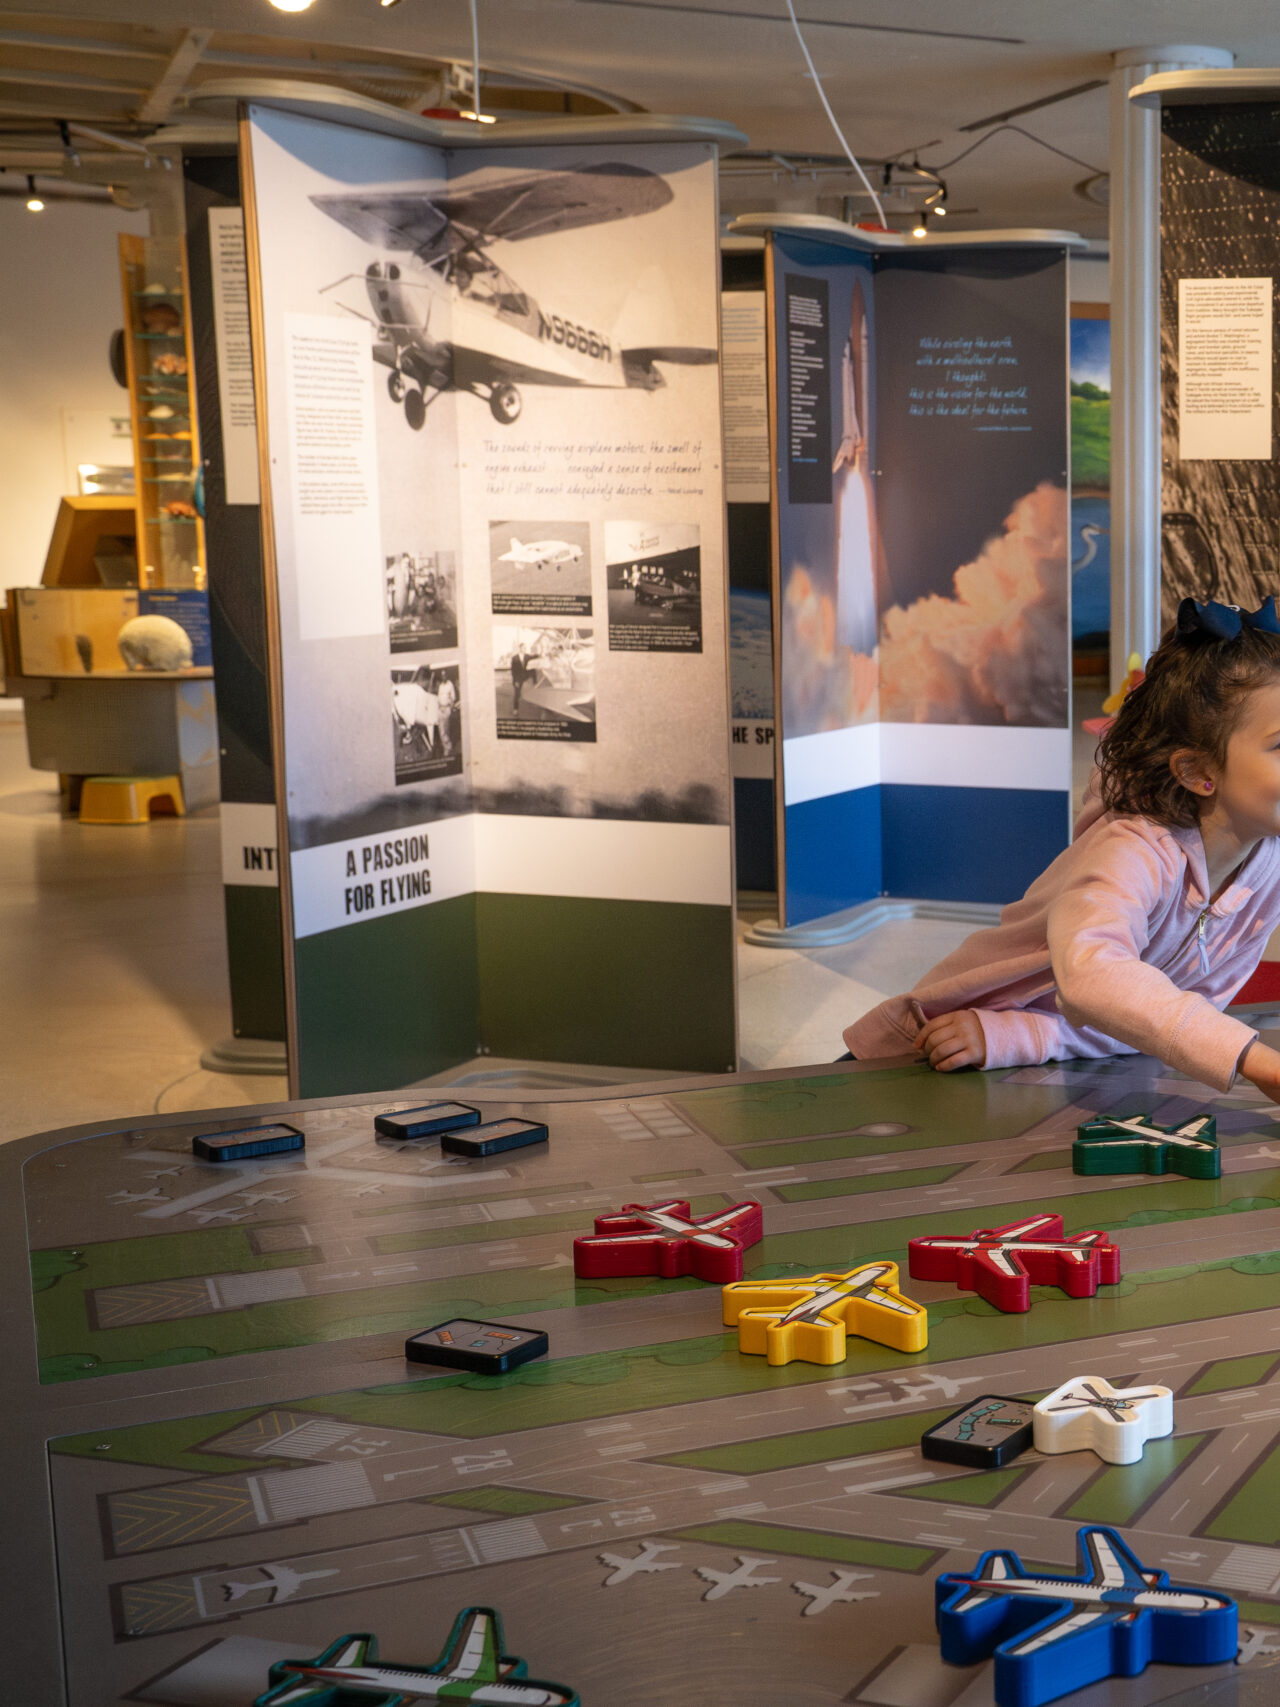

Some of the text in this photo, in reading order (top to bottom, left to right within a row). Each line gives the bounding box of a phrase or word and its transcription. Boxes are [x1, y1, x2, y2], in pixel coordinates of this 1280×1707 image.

[975, 336, 988, 348] the
[936, 387, 949, 398] the
[989, 387, 1002, 398] the
[936, 404, 949, 415] the
[986, 404, 999, 415] the
[484, 440, 499, 453] The
[650, 441, 664, 453] the
[732, 726, 749, 744] HE
[346, 834, 430, 877] A PASSION
[345, 869, 432, 915] FOR FLYING
